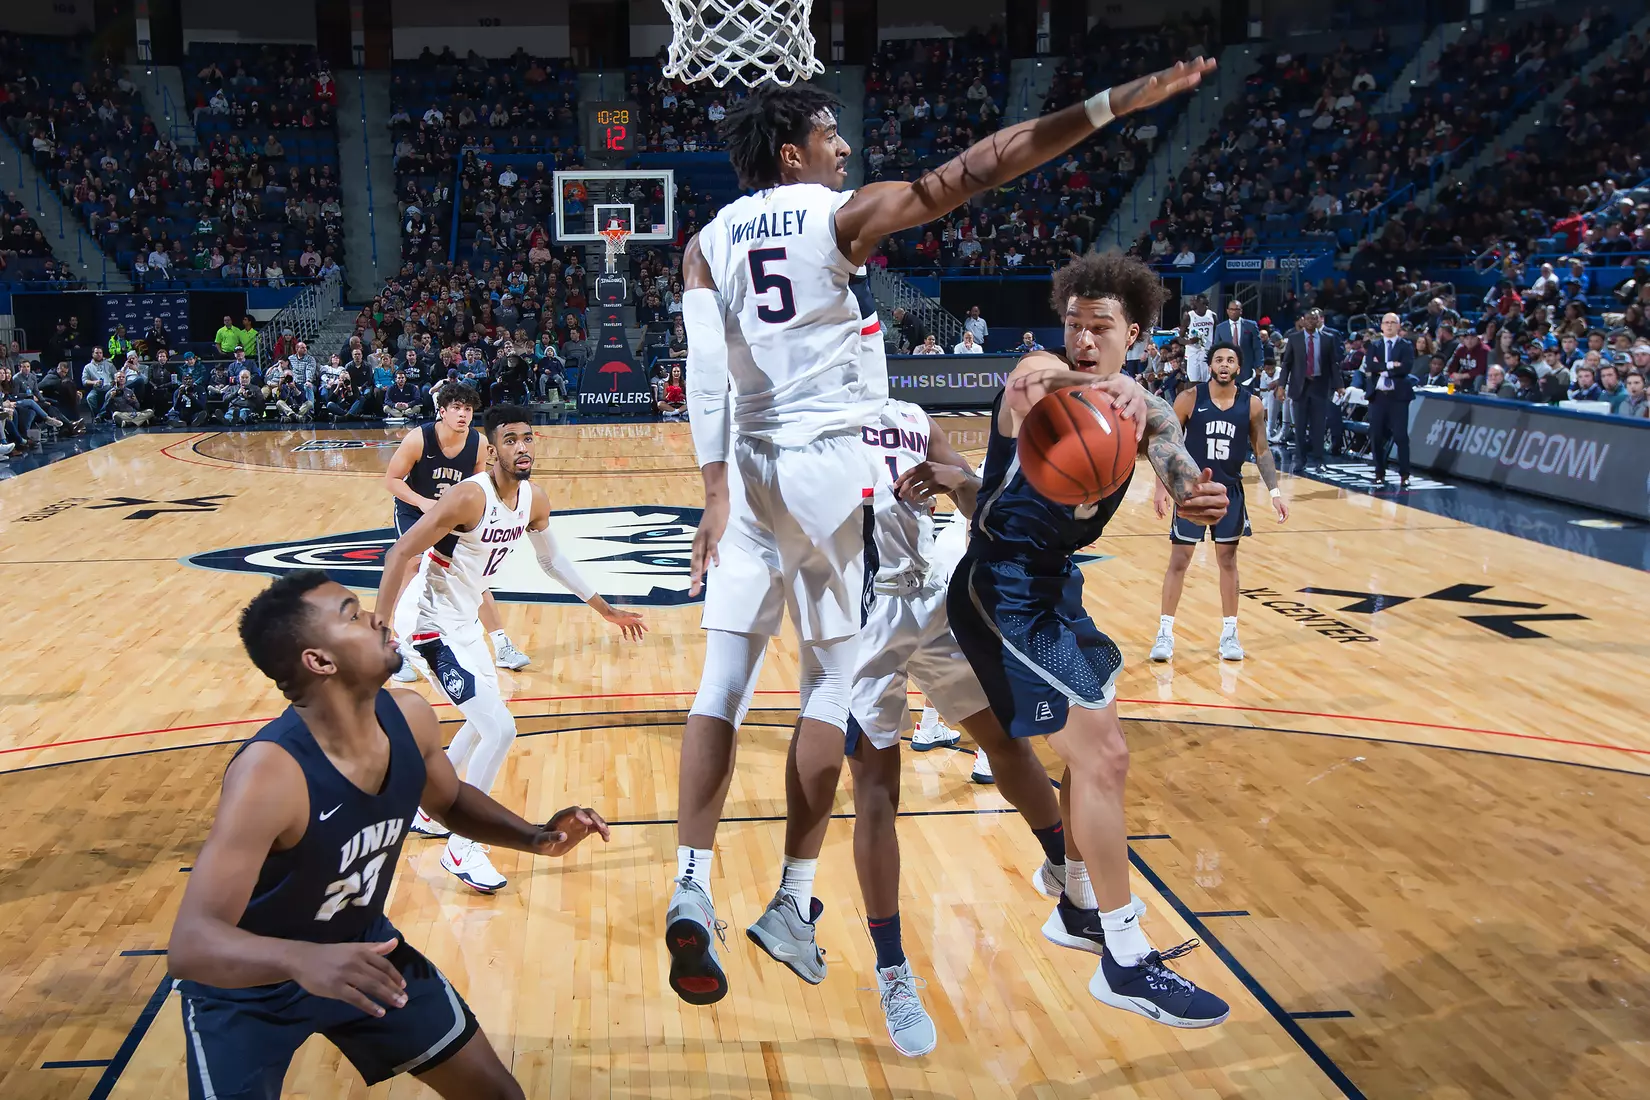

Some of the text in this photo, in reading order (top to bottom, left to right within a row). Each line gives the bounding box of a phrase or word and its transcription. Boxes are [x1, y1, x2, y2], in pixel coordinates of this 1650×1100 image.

[597, 110, 629, 125] 10:28
[606, 125, 626, 151] 12
[731, 209, 807, 246] WHALEY
[1241, 260, 1260, 268] LIGHT
[747, 246, 797, 324] 5
[579, 392, 651, 405] TRAVELERS
[1205, 420, 1237, 439] UNH
[1206, 437, 1230, 461] 15
[1425, 418, 1610, 482] #THISISUCONN
[431, 466, 463, 482] UNH
[884, 455, 900, 484] 1
[481, 525, 525, 544] UCONN
[482, 547, 509, 577] 12
[1261, 600, 1379, 643] CENTER
[339, 818, 404, 874] UNH
[313, 852, 389, 922] 23
